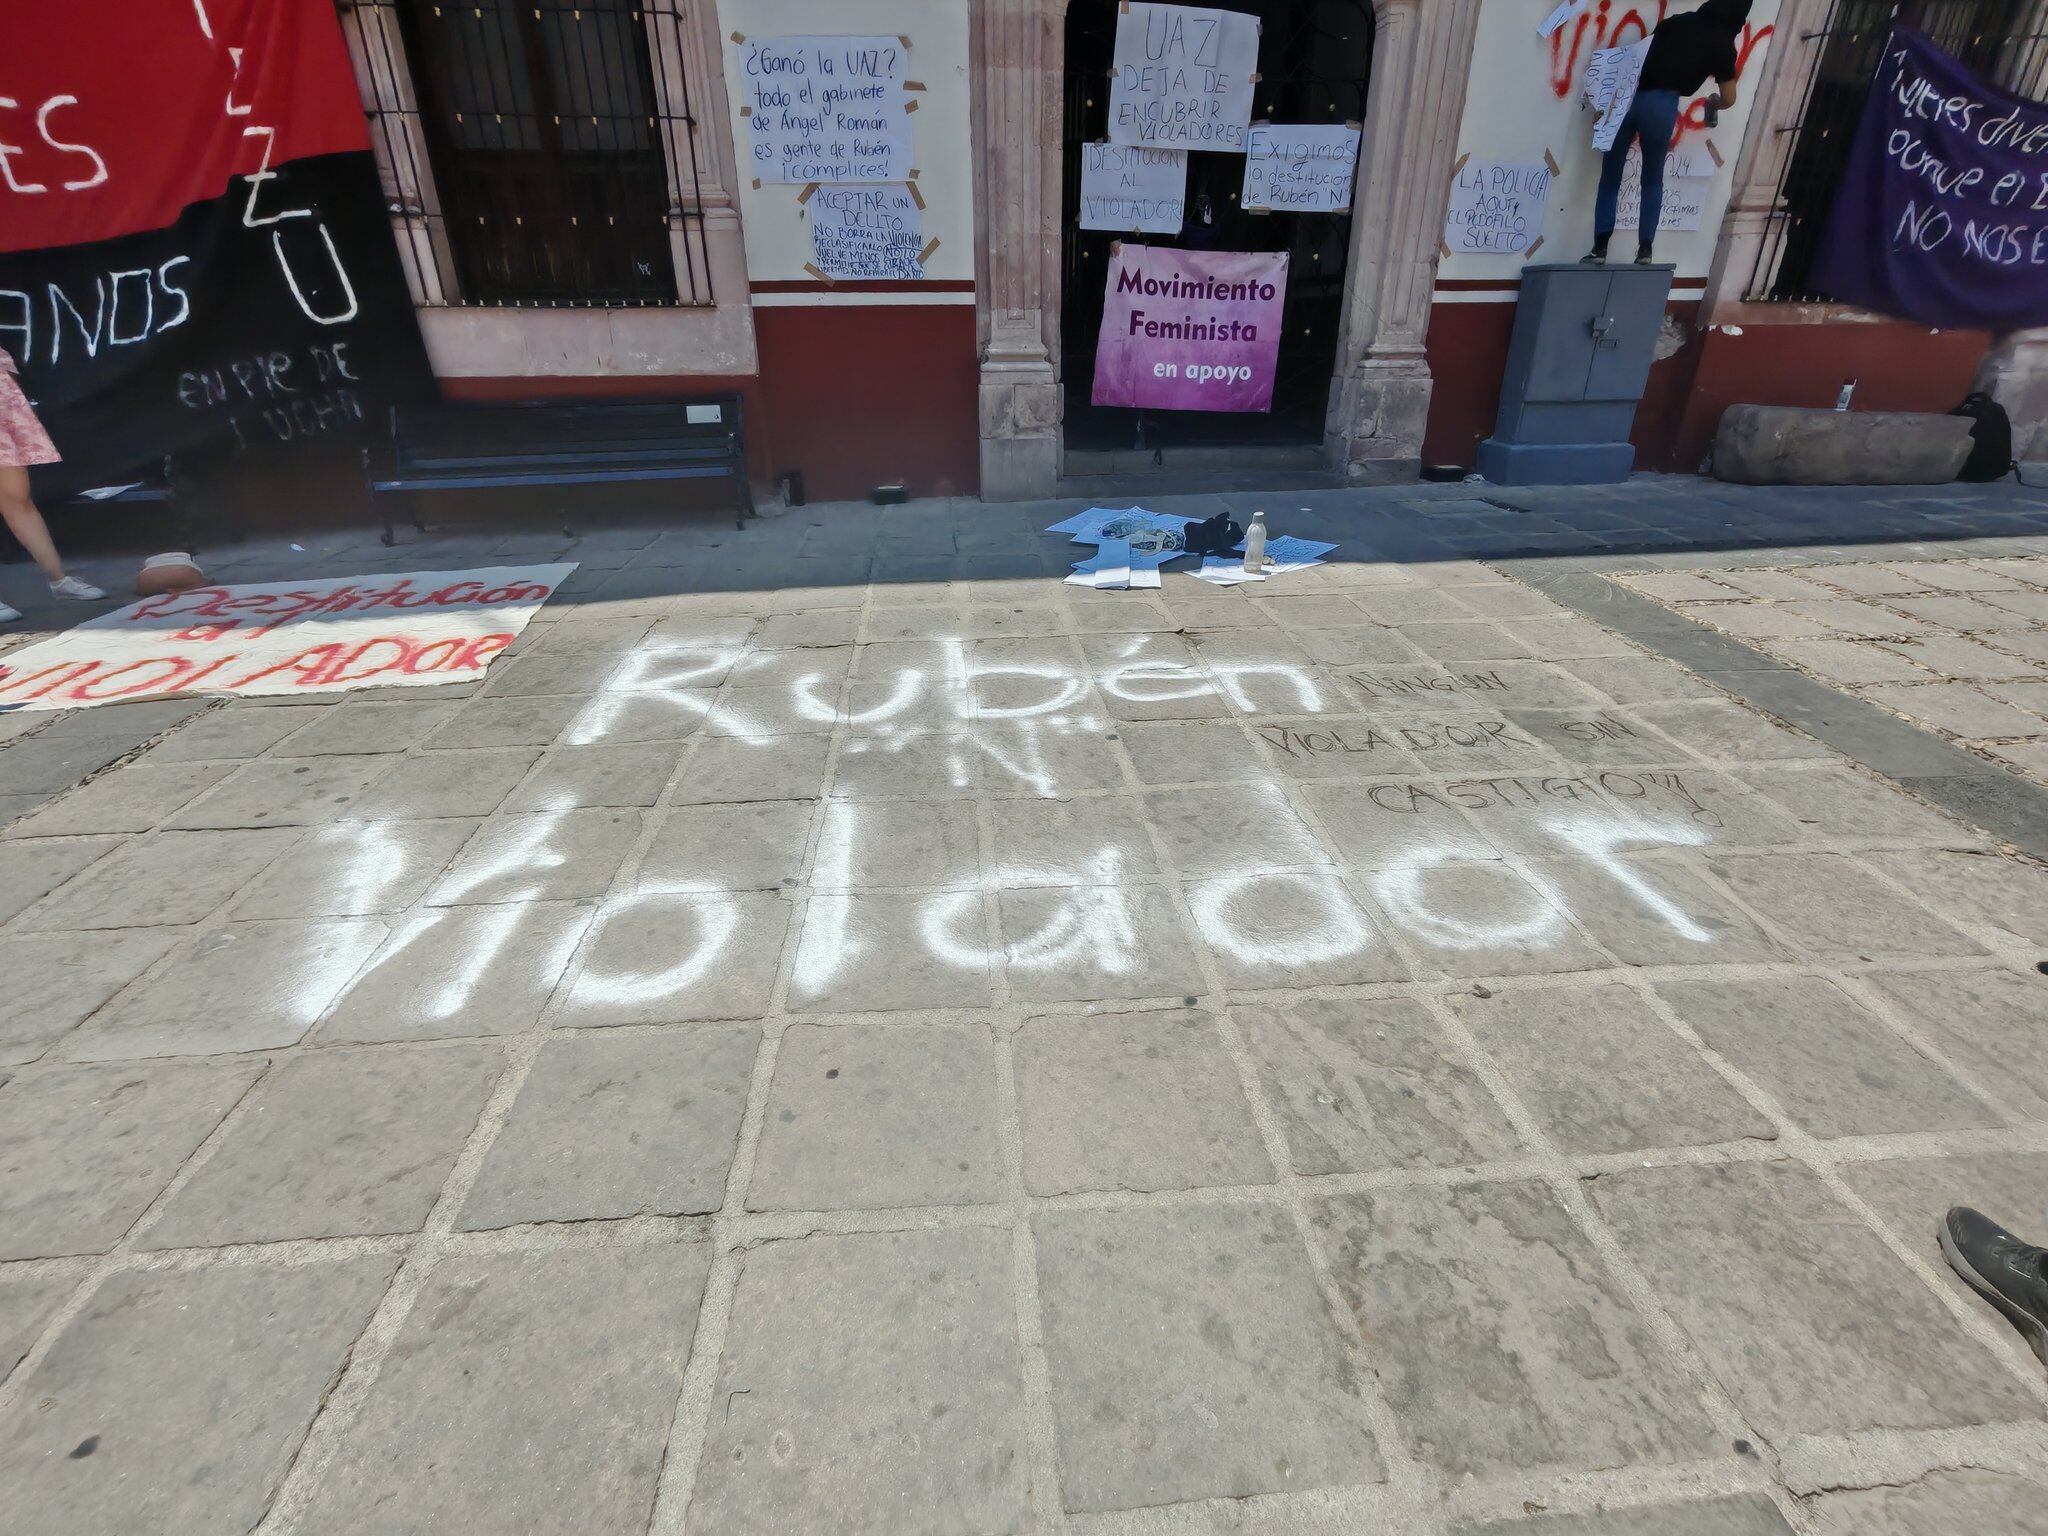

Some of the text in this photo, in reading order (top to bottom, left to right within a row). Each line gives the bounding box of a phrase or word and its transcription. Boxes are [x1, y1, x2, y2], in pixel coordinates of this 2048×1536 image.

[1145, 9, 1217, 67] UAZ
[747, 44, 895, 78] ¿Ganó la UAZ?
[1123, 64, 1229, 96] DEJA DE
[755, 79, 885, 115] todo el gabinete
[753, 110, 887, 137] de Ángel Román
[1118, 99, 1221, 125] ENCUBRIR
[1139, 121, 1244, 146] VIOLADORES
[755, 138, 890, 162] es gente de Rubén
[1250, 131, 1357, 172] Exigimos
[782, 160, 889, 181] ¡cómplices!
[1120, 172, 1144, 187] AL
[1249, 165, 1352, 185] la destitución
[1460, 168, 1484, 191] LA
[817, 186, 909, 211] ACEPTAR UN
[1242, 184, 1262, 204] de
[1270, 184, 1319, 204] Rubén
[814, 222, 833, 237] NO
[838, 226, 873, 239] BORRA
[876, 232, 887, 242] LA
[842, 210, 902, 230] DELITO
[1893, 200, 1952, 251] NO
[1962, 219, 2028, 265] NOS
[1463, 226, 1528, 251] SUELTO
[884, 244, 902, 258] NO
[904, 250, 916, 259] LO
[1116, 265, 1276, 301] Movimiento
[1129, 310, 1257, 341] Feminista
[1153, 362, 1252, 385] en apoyo
[565, 634, 1322, 746] Rubén
[1255, 712, 1640, 759] VIOLADOR SIN
[283, 778, 1716, 1024] Violador
